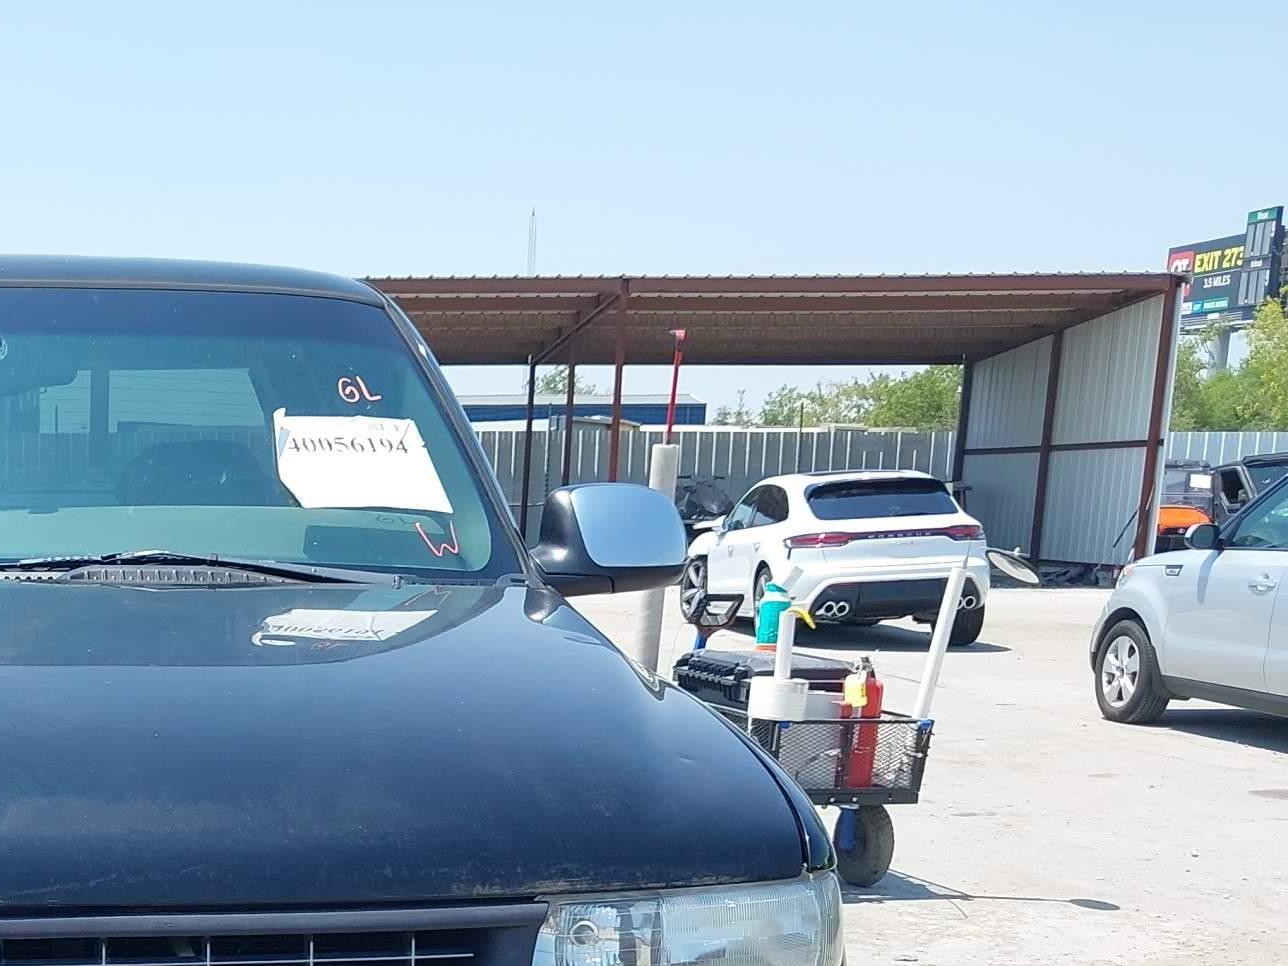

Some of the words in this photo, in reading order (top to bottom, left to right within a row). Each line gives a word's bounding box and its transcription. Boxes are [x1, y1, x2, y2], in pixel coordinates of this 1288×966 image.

[1194, 250, 1221, 273] EXIT
[1213, 275, 1231, 287] MILES
[287, 436, 409, 454] 40056194
